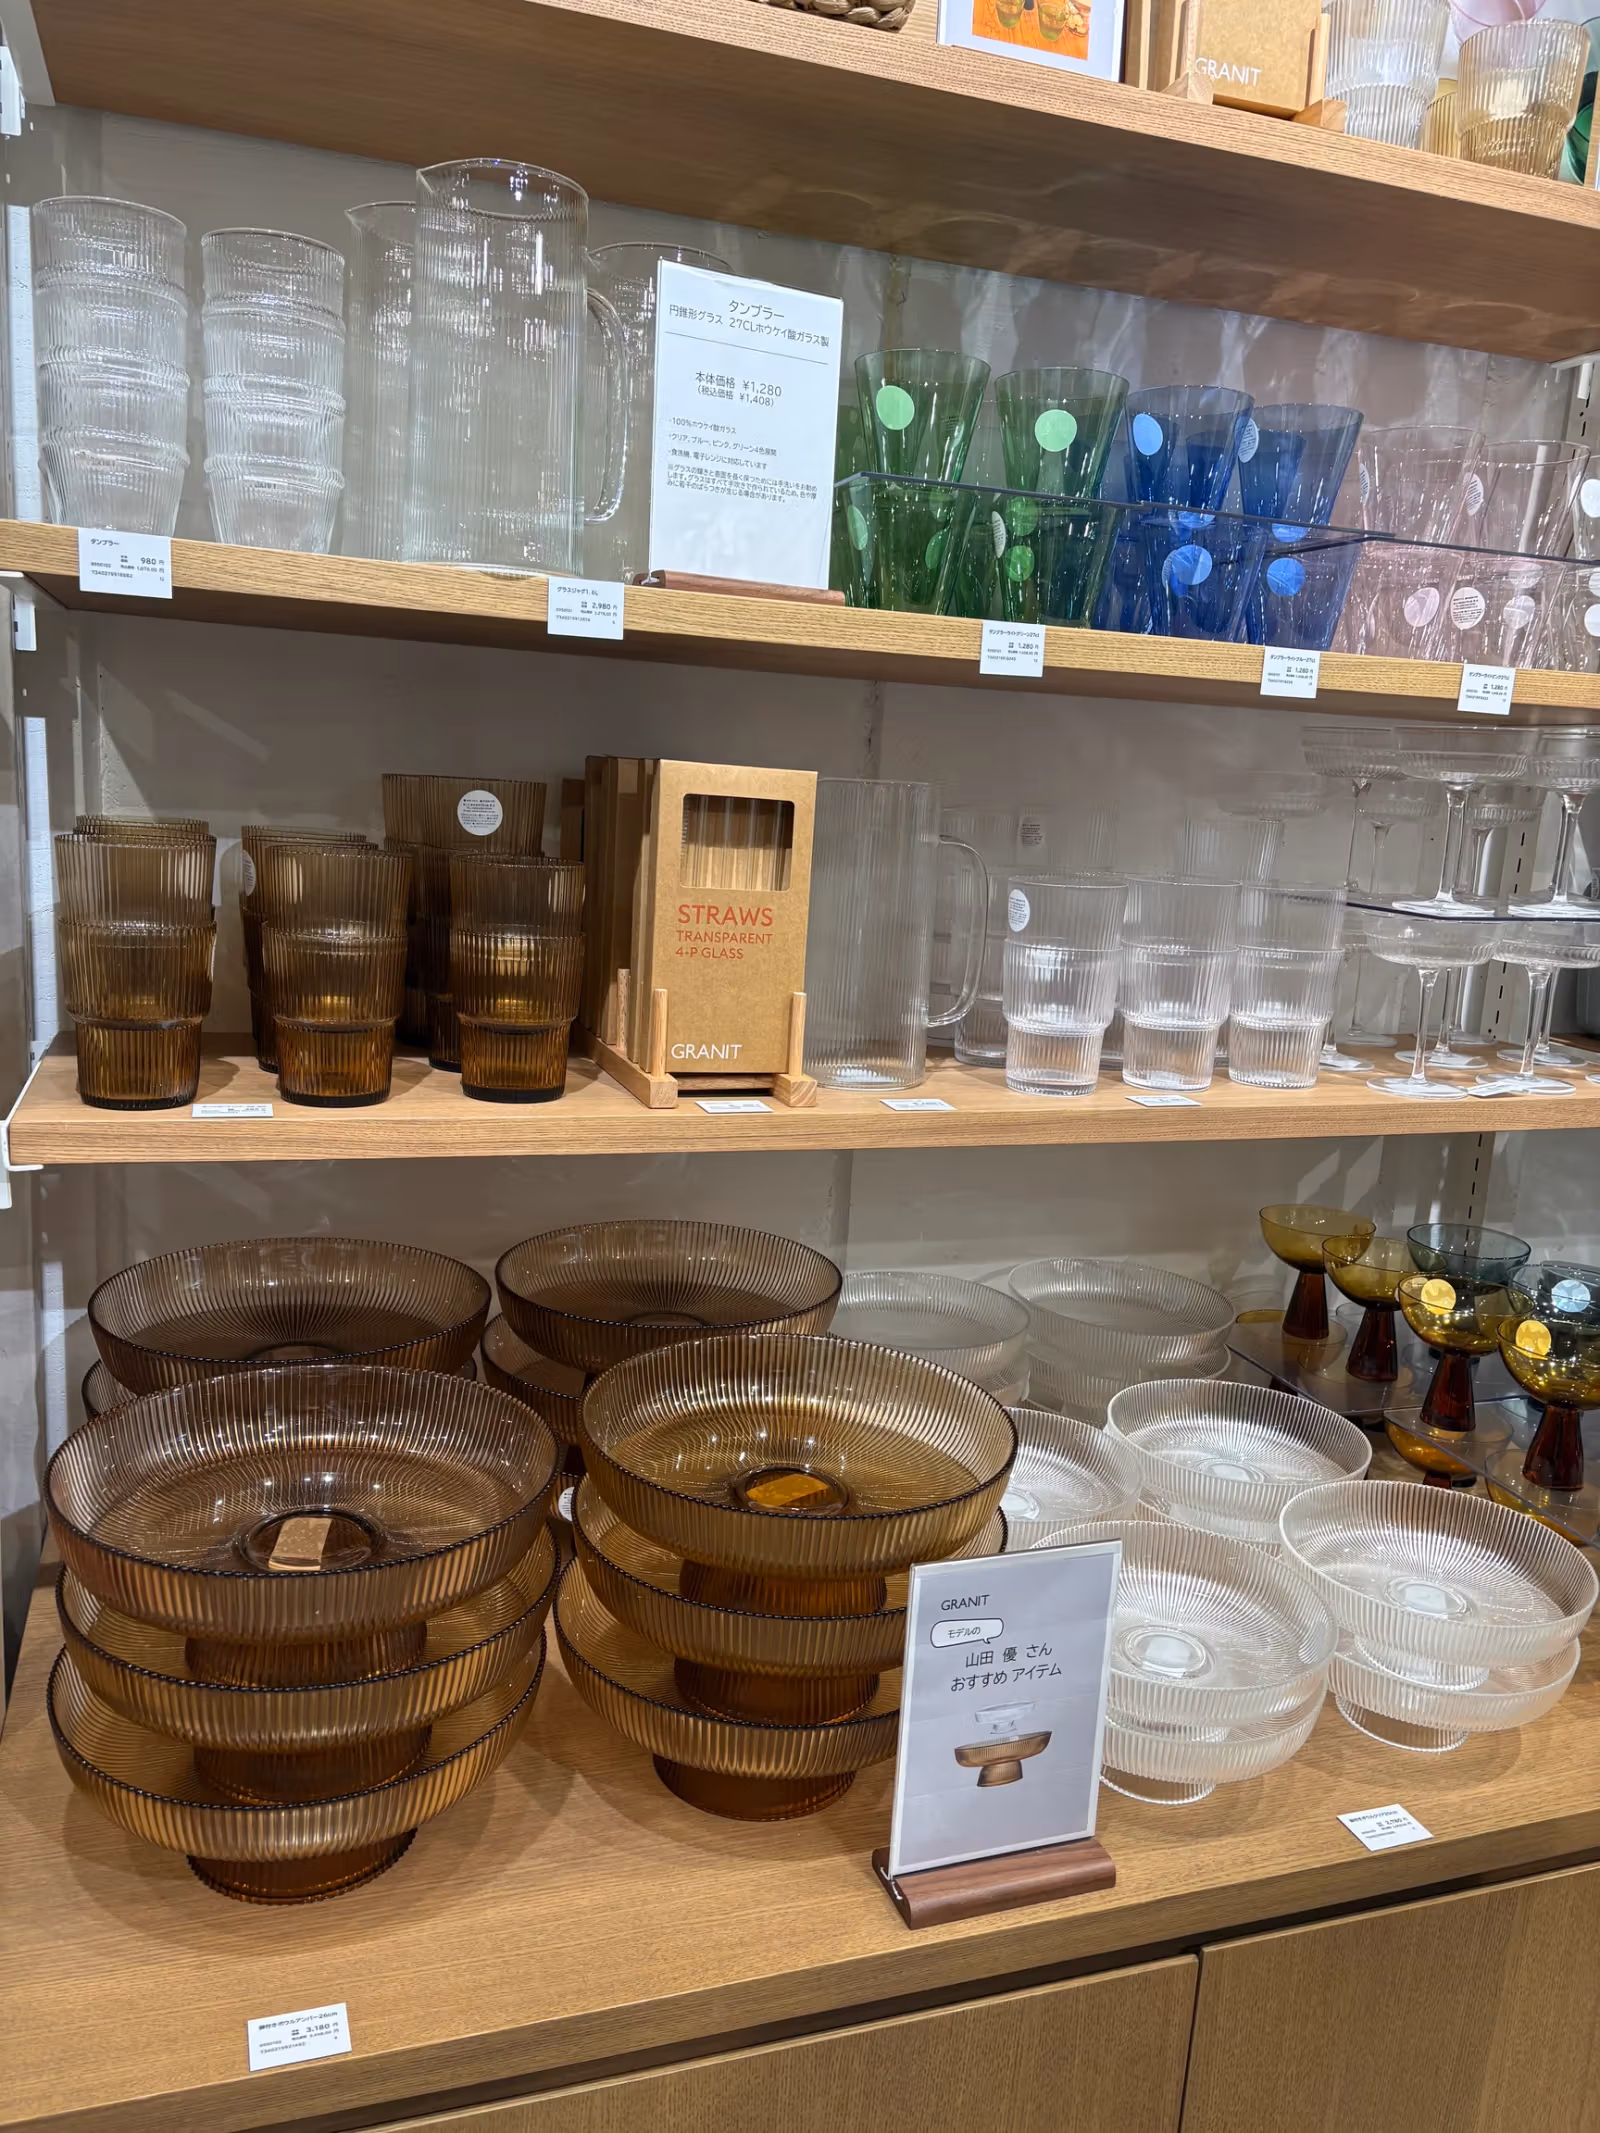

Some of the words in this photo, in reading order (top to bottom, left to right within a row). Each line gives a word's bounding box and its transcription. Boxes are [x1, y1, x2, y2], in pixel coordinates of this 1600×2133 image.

[1194, 57, 1262, 87] GRANIT
[728, 300, 785, 320] タンブラー
[669, 304, 723, 325] 円錐形グラス
[729, 317, 830, 348] 27CLホウケイ酸ガラス製
[695, 370, 736, 389] 本体価格
[742, 380, 782, 397] ¥1,280
[697, 385, 734, 400] (税込価格
[740, 392, 774, 407] ¥1,408)
[140, 557, 156, 565] 980
[592, 602, 611, 610] 2,980
[678, 904, 773, 927] STRAWS
[676, 930, 773, 945] TRANSPARENT
[675, 946, 698, 958] 4-P
[701, 948, 744, 960] GLASS
[671, 1044, 742, 1060] GRANIT
[940, 1594, 990, 1612] GRANIT
[948, 1626, 981, 1639] モデルの
[965, 1650, 994, 1668] 山田
[1003, 1646, 1018, 1663] 優
[1026, 1643, 1052, 1659] さん
[950, 1670, 1008, 1693] おすすめ
[1012, 1662, 1062, 1683] アイテム
